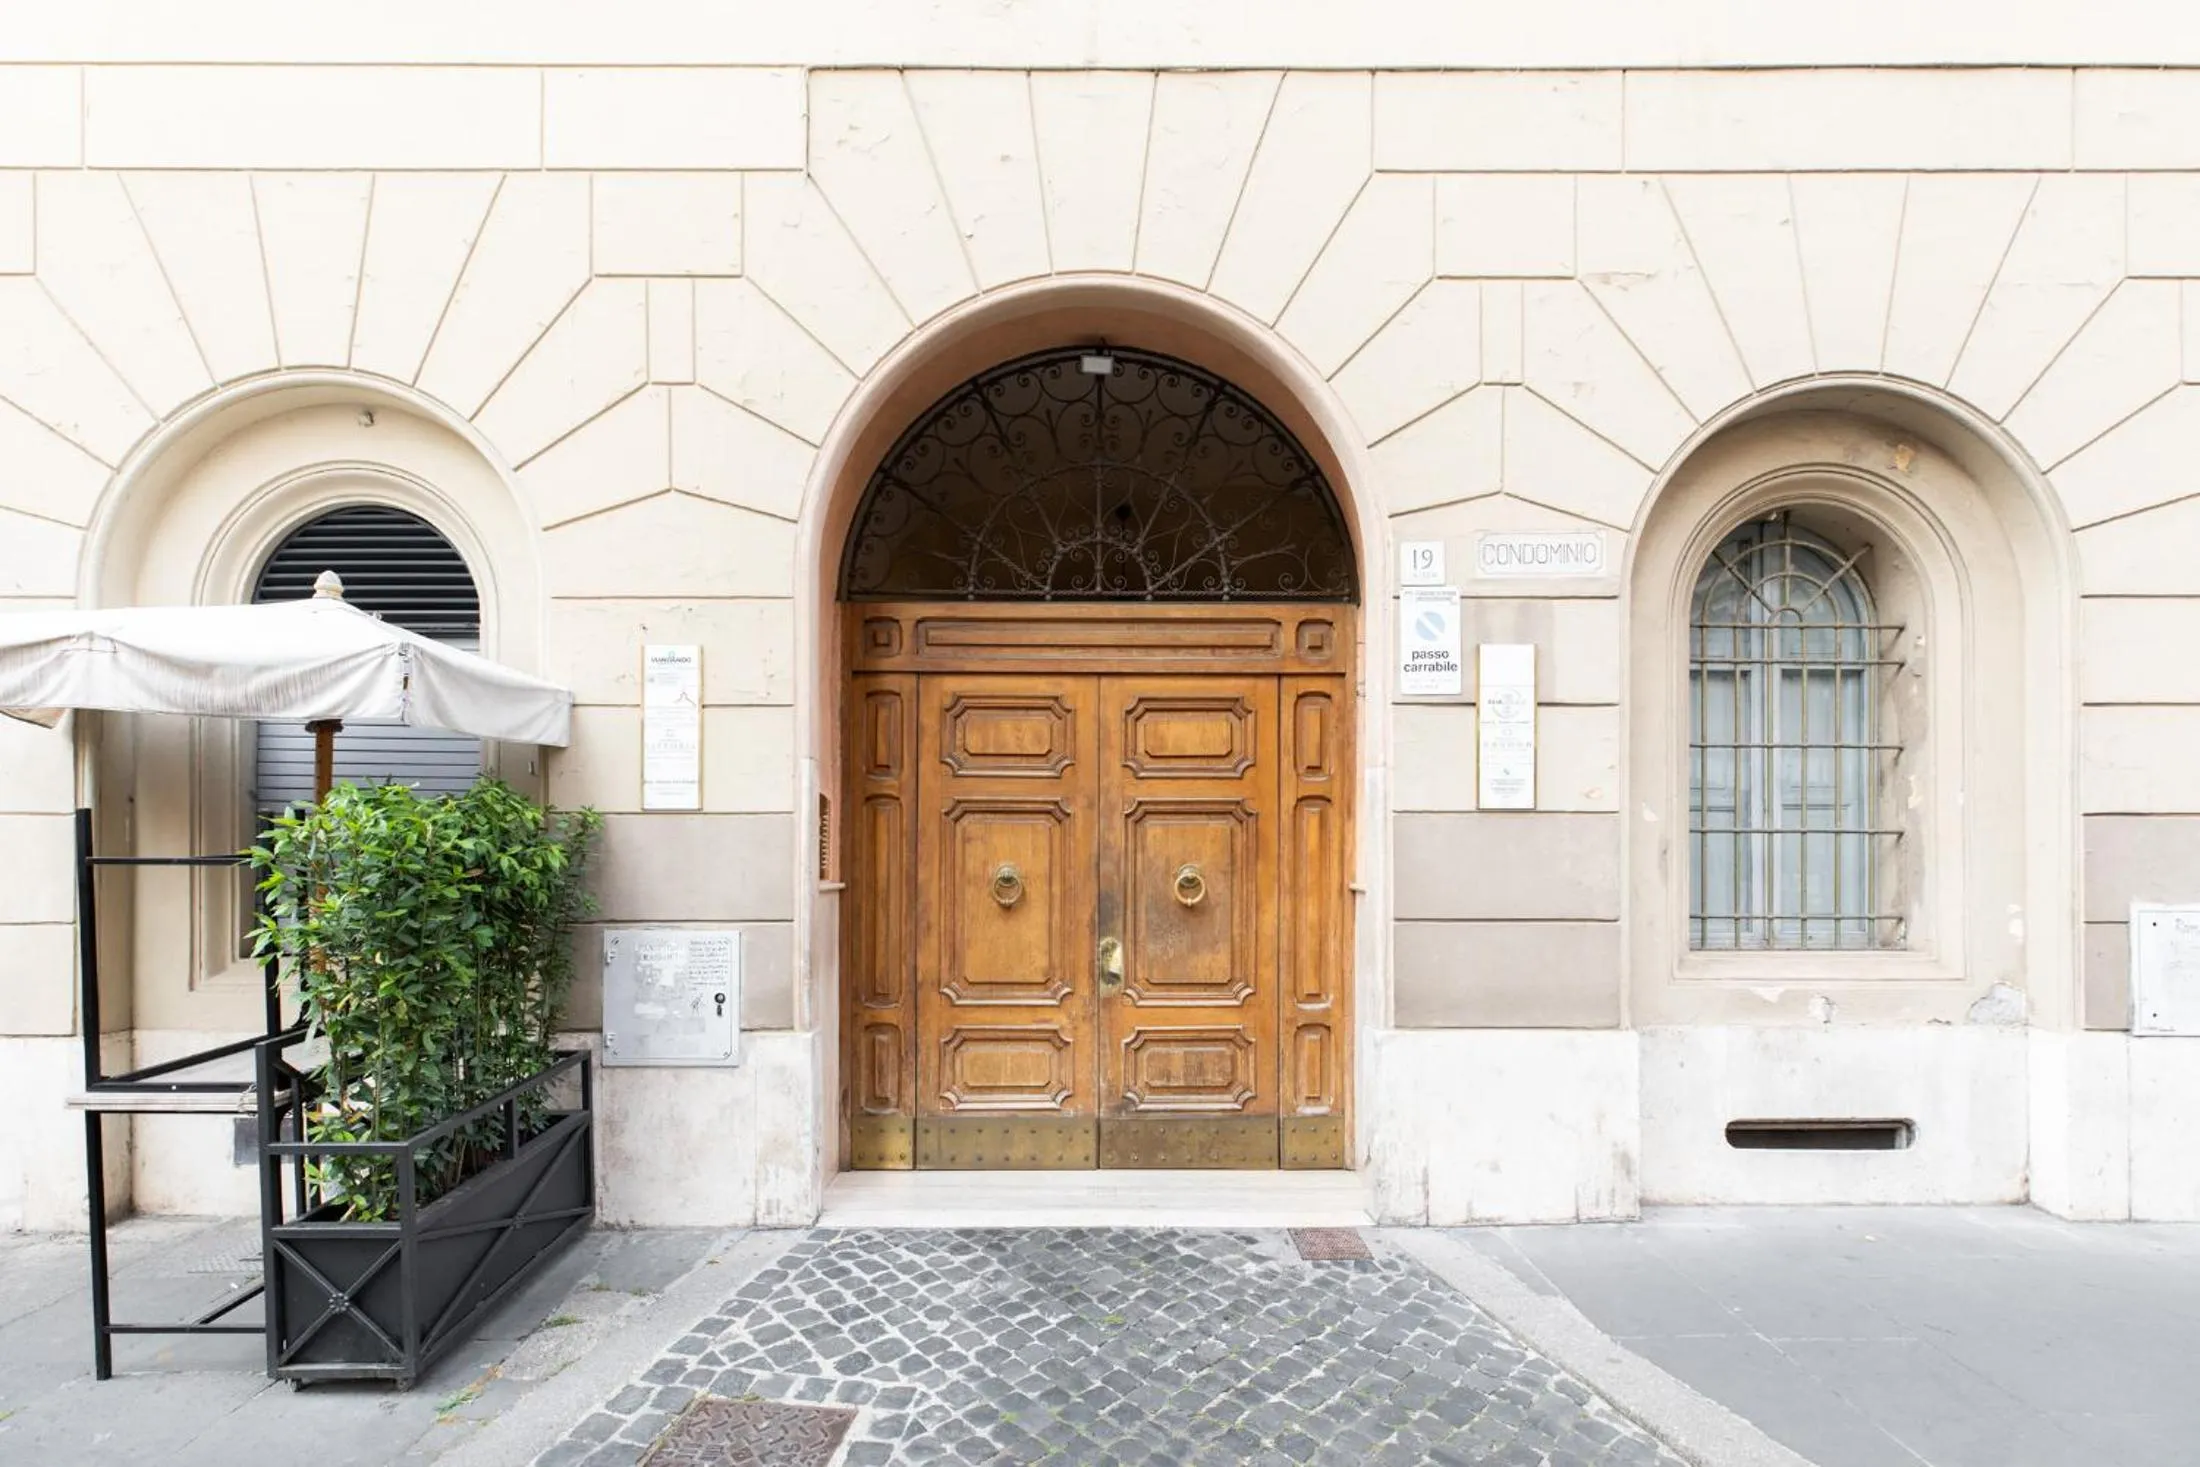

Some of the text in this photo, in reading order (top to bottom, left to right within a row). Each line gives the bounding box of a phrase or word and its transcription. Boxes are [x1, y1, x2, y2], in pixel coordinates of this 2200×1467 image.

[1412, 548, 1434, 570] 19
[1482, 542, 1597, 565] CONDOMINIO
[1411, 650, 1449, 661] passo
[1403, 661, 1458, 672] carrabile
